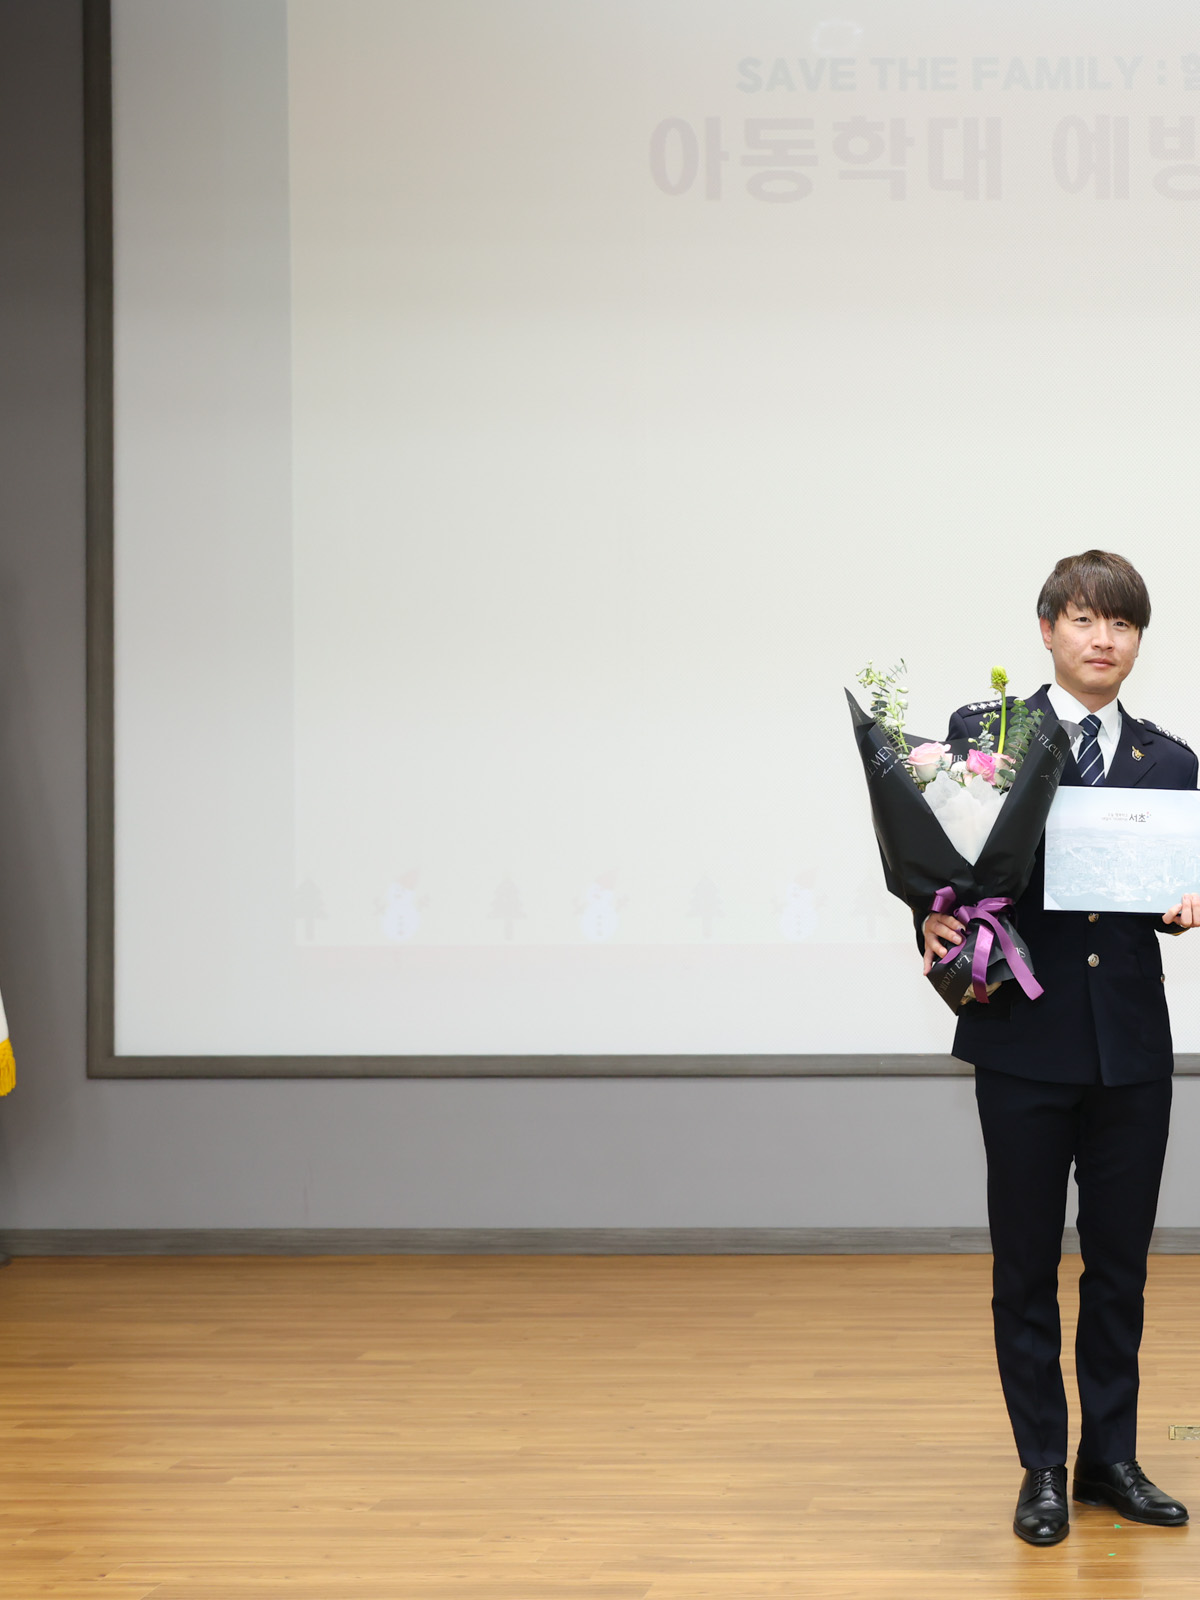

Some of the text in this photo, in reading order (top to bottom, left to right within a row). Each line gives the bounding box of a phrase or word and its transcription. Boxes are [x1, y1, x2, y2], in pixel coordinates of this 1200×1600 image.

[736, 56, 857, 93] SAVE
[869, 56, 958, 92] THE
[971, 56, 1144, 92] FAMILY
[648, 115, 1004, 203] 아동학대
[1129, 813, 1146, 823] 서초
